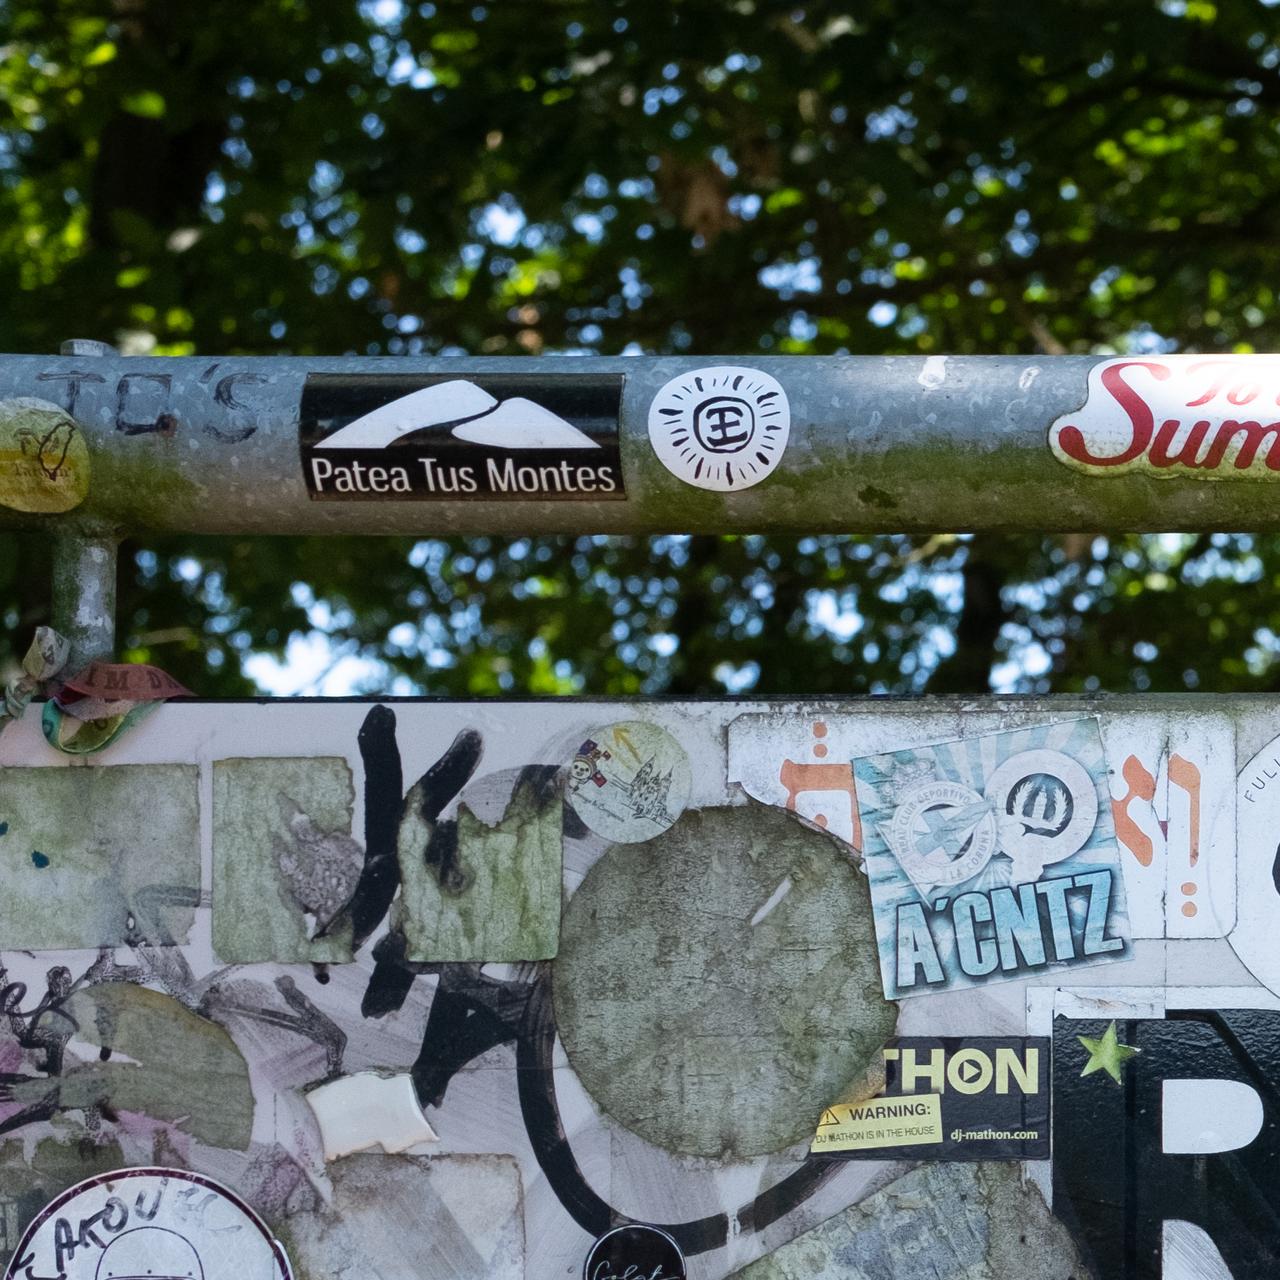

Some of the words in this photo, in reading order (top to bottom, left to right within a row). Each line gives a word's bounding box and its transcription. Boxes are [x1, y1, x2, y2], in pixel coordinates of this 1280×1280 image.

[312, 457, 412, 494] Patea
[418, 457, 478, 493] Tus
[486, 459, 617, 494] Montes
[850, 1103, 931, 1121] WARNING:
[886, 1128, 904, 1138] THE
[905, 1126, 935, 1137] HOUSE
[950, 1128, 1038, 1142] dj-mathon.com
